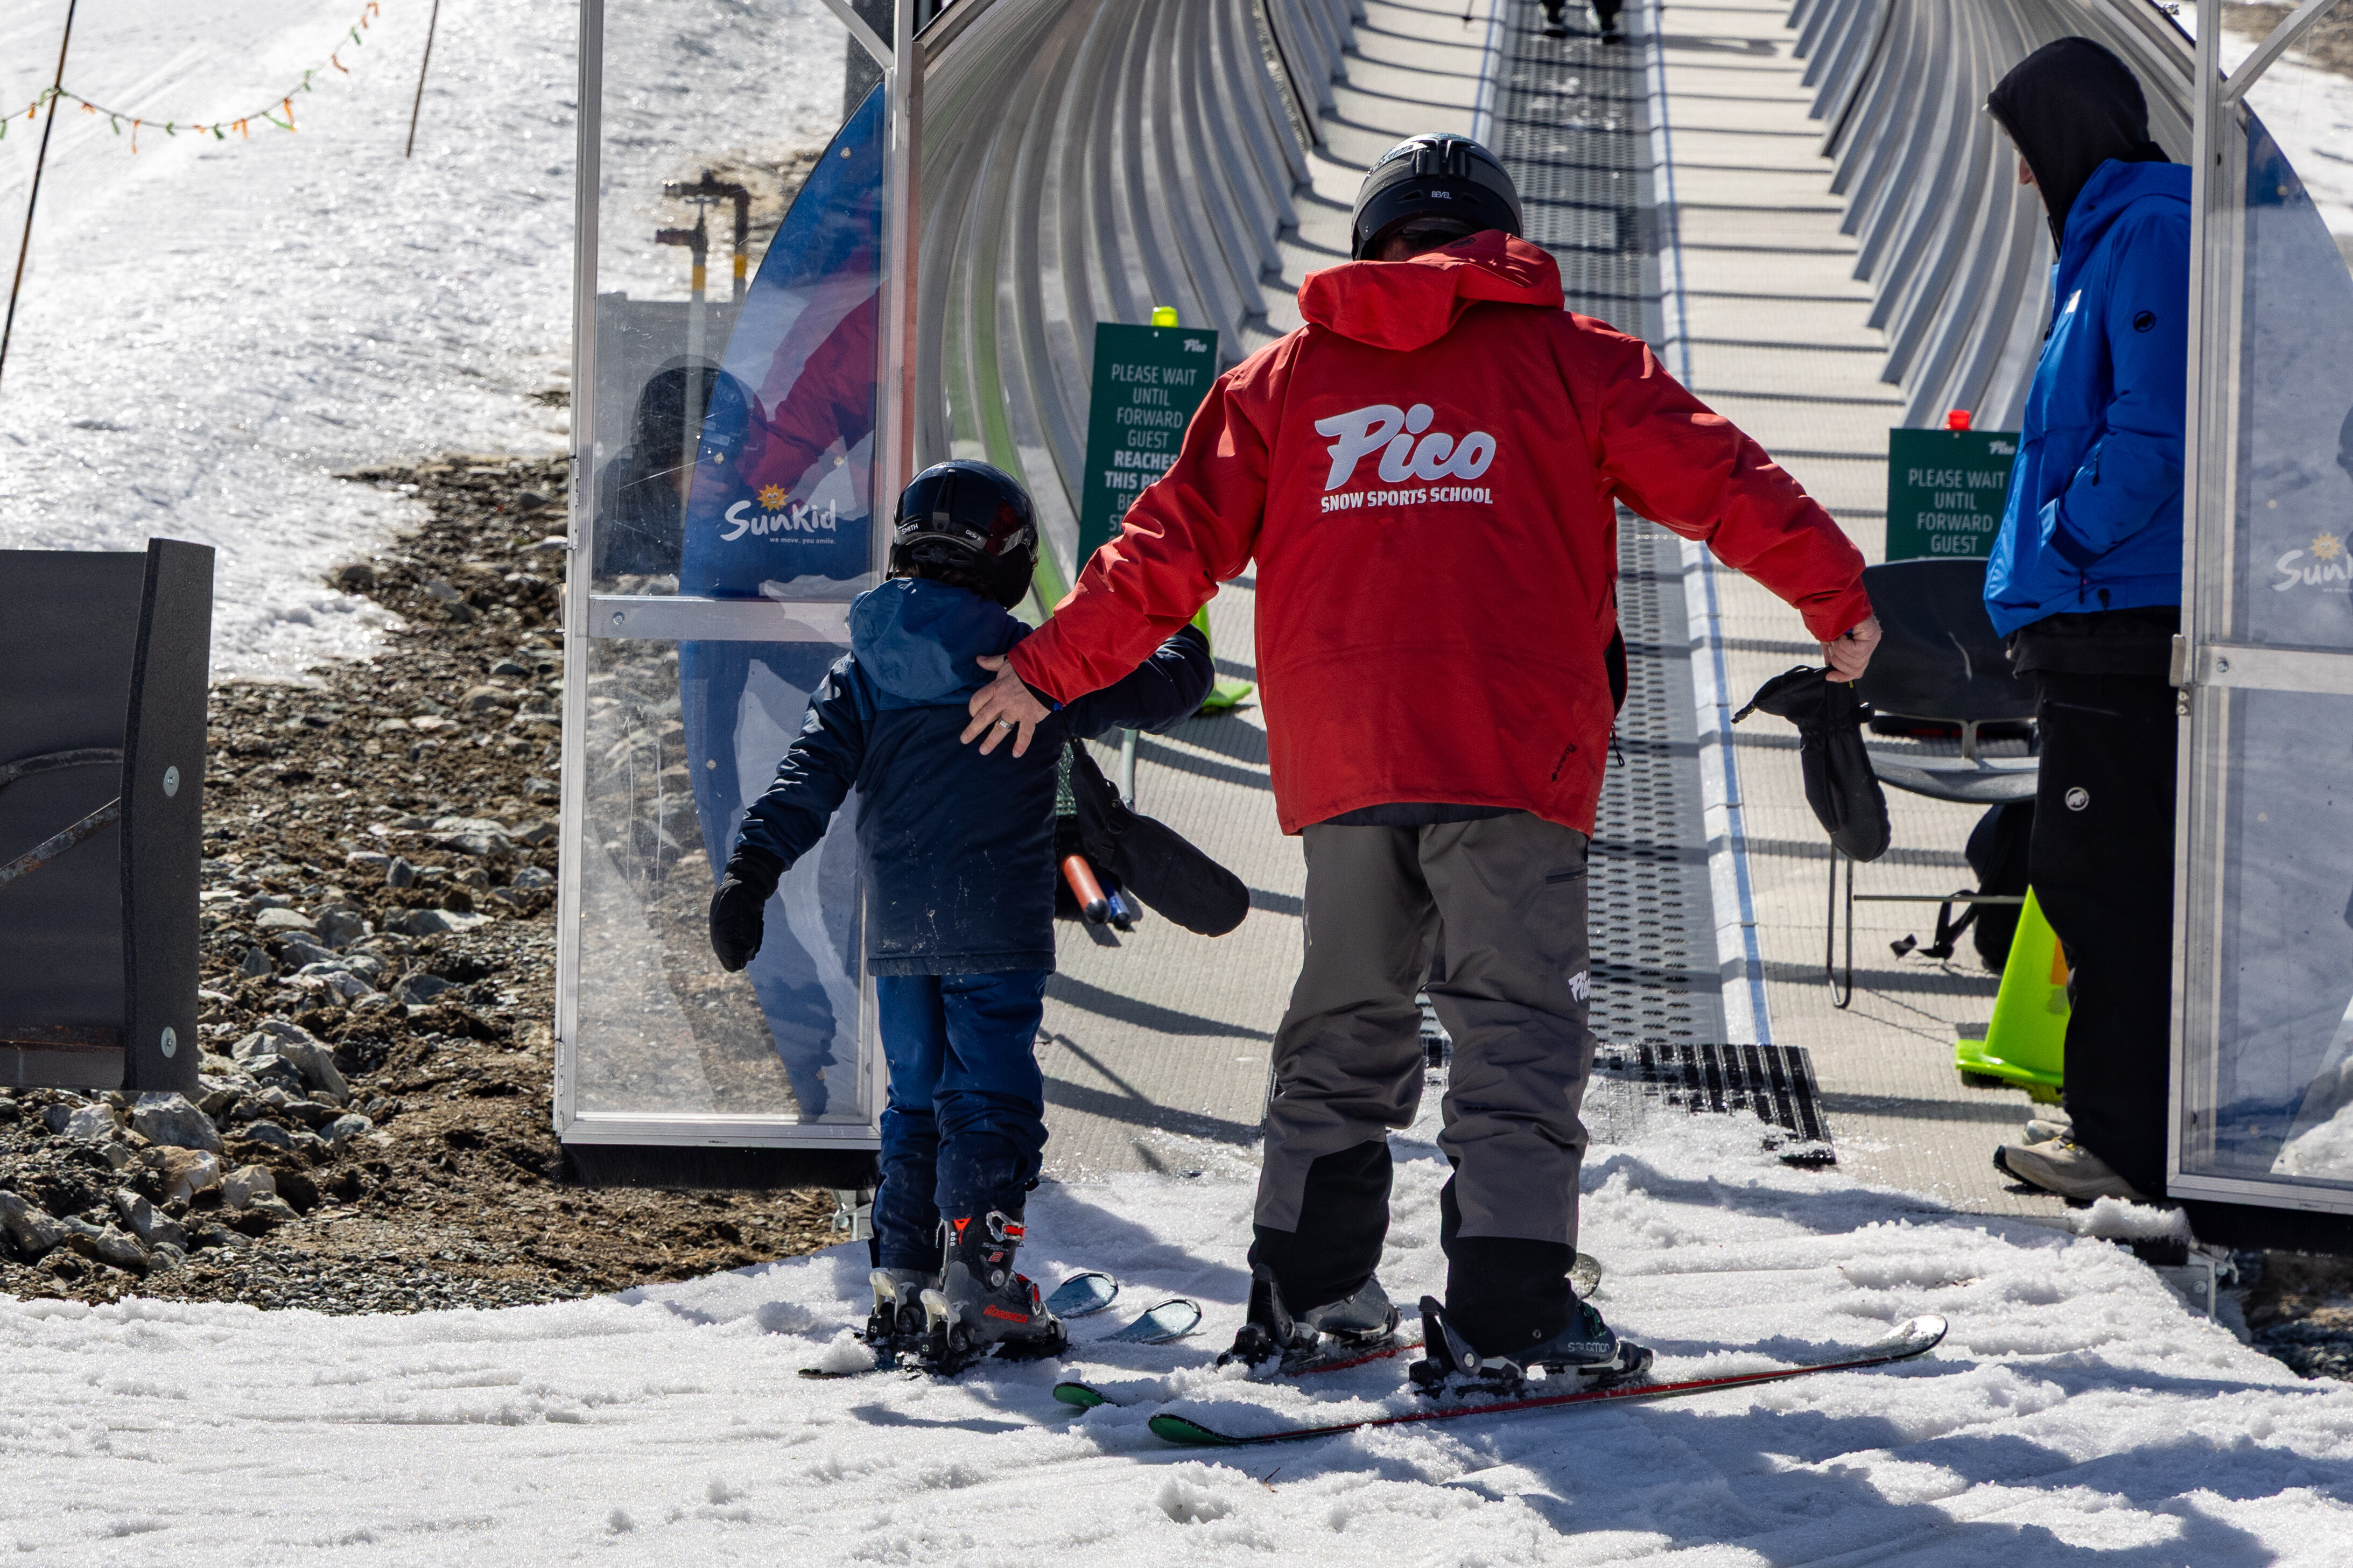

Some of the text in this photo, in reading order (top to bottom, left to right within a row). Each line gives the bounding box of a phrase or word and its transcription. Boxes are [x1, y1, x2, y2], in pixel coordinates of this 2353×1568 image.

[1431, 190, 1452, 199] BEVEL
[1111, 363, 1198, 386] PLEASE WAIT
[1132, 386, 1171, 406] UNTIL
[1116, 406, 1184, 429] FORWARD
[1127, 428, 1170, 449] GUEST
[1315, 403, 1497, 491] Pico
[1104, 470, 1138, 490] THIS
[1908, 468, 2006, 490] PLEASE WAIT
[1321, 486, 1494, 513] SNOW SPORTS SCHOOL
[1934, 491, 1978, 511] UNTIL
[902, 523, 918, 535] SMITH
[1916, 511, 1993, 533] FORWARD
[1930, 534, 1979, 554] GUEST
[988, 1252, 1003, 1262] 2
[984, 1305, 1027, 1323] NORDICA
